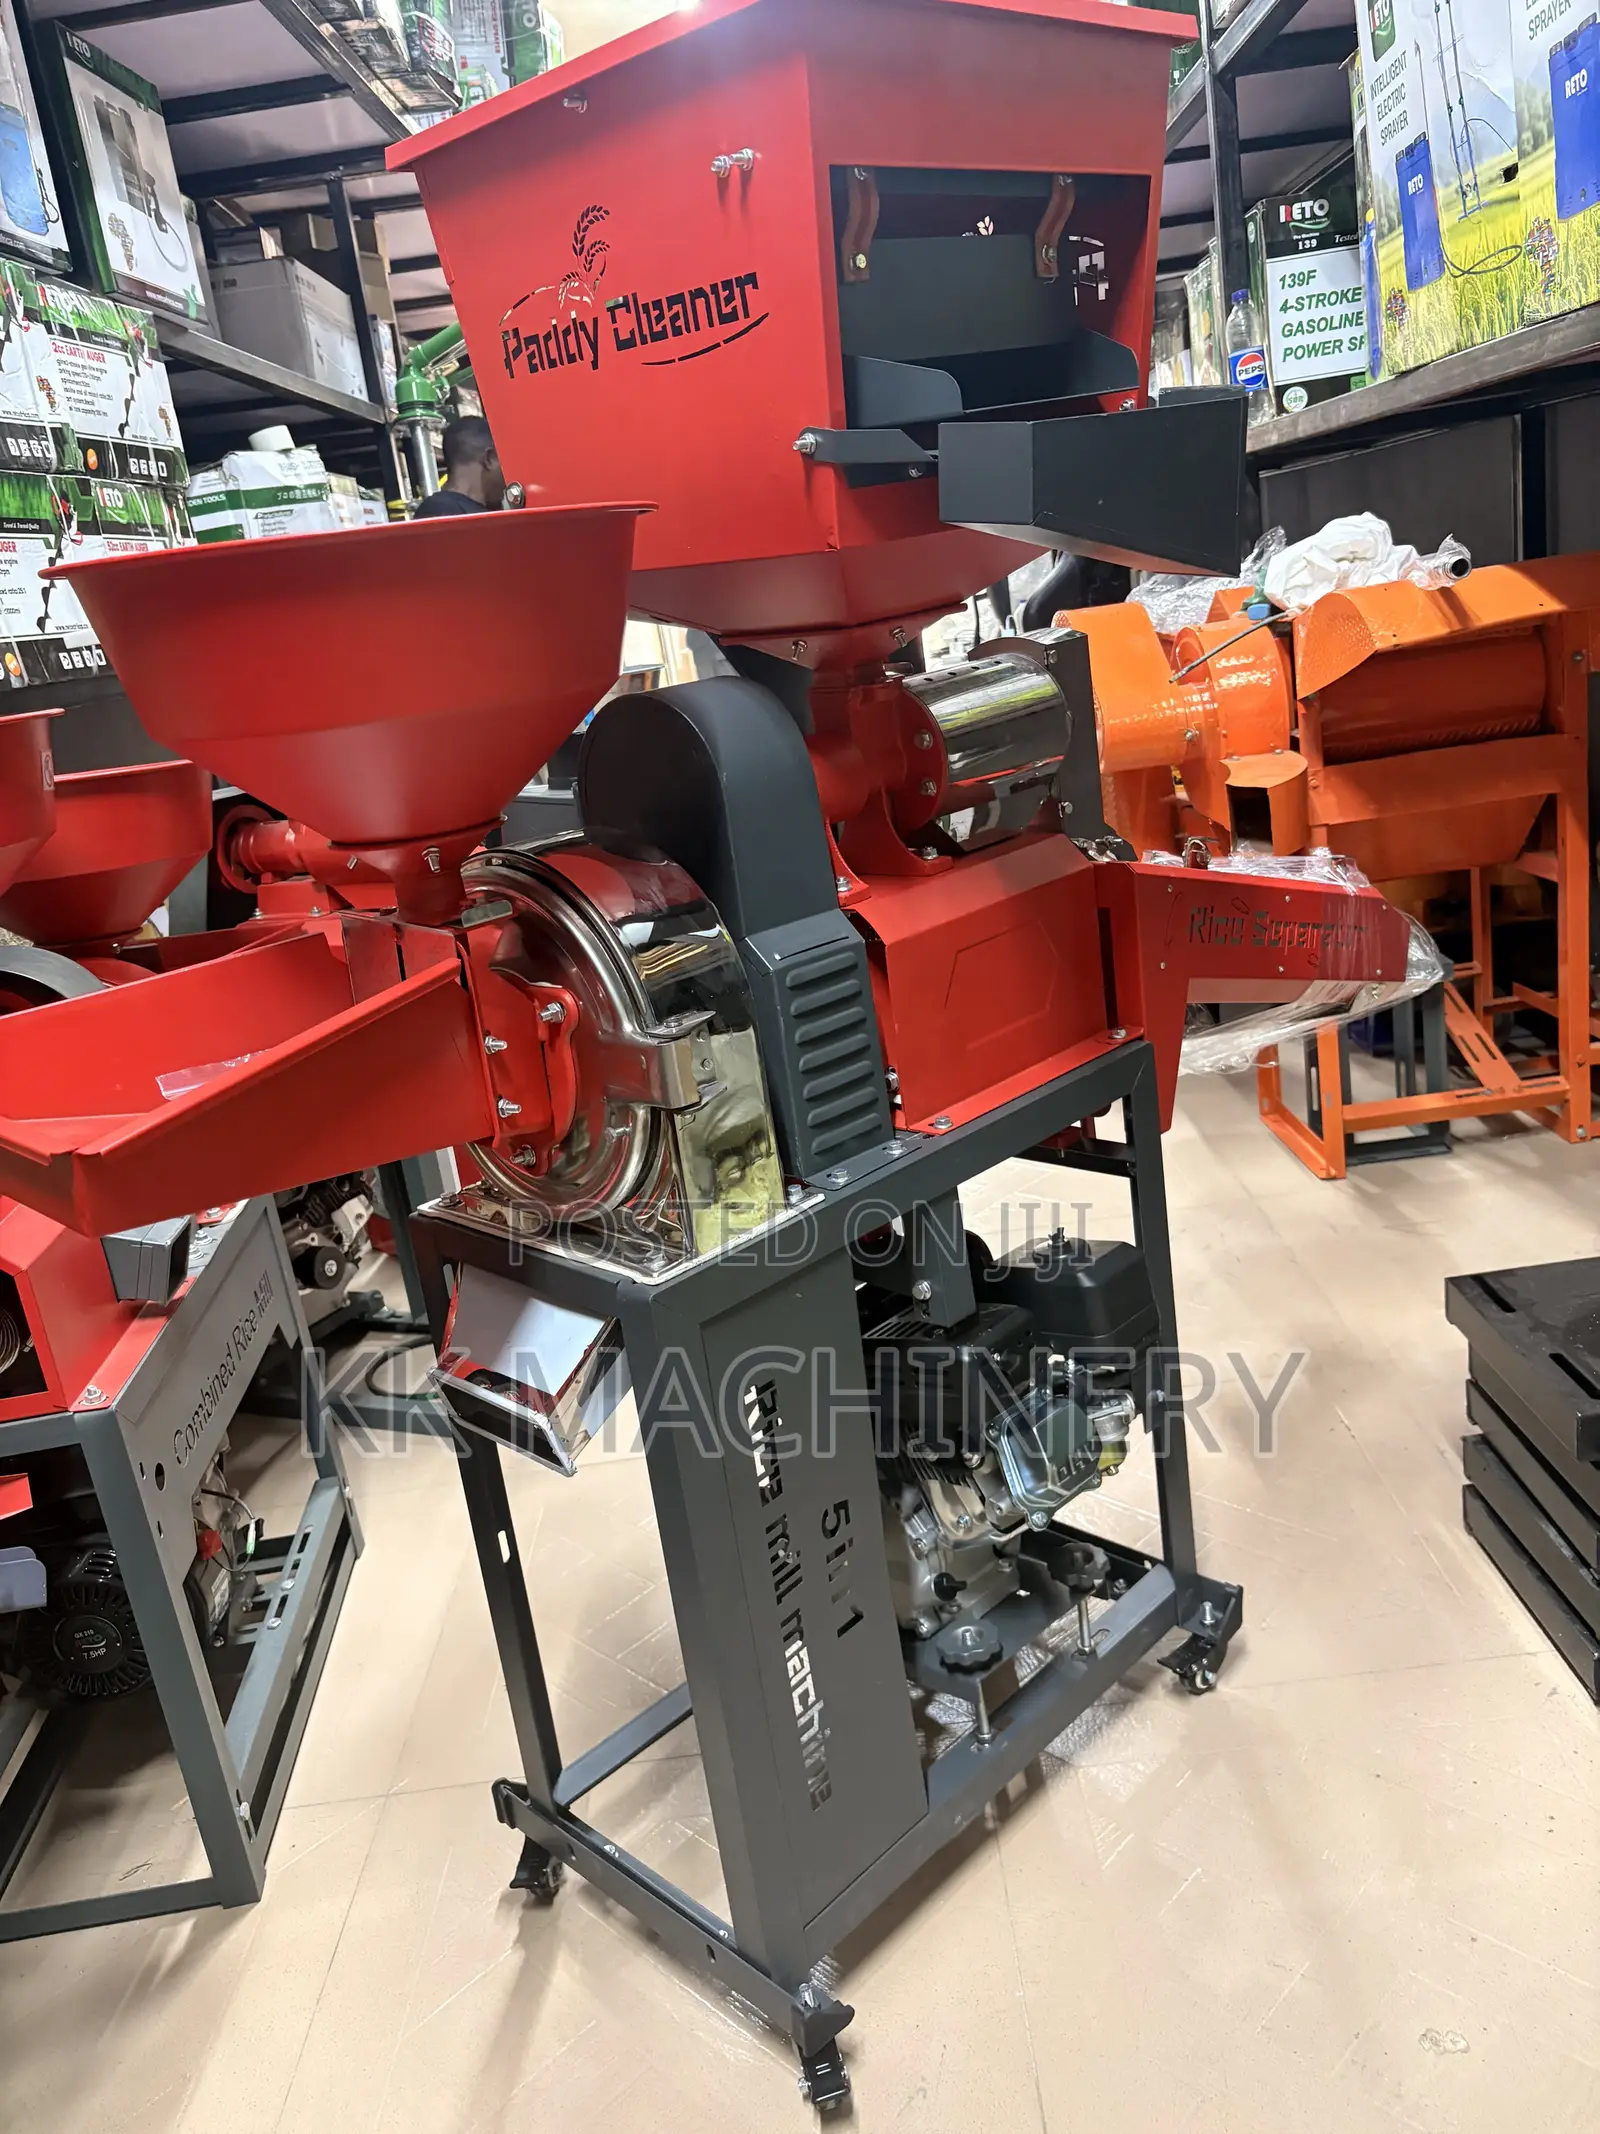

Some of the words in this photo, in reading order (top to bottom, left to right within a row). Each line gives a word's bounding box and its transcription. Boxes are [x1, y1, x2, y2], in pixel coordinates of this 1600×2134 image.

[1370, 50, 1408, 101] INTELLIGENT
[1565, 68, 1588, 99] RETO
[1377, 82, 1407, 122] ELECTRIC
[1380, 109, 1409, 146] SPRAYER
[1408, 173, 1424, 196] RETO
[1280, 198, 1330, 223] RETO
[1298, 239, 1318, 250] 139
[1279, 269, 1317, 290] 139F
[1280, 286, 1363, 314] 4-STROKE
[501, 310, 600, 380] Paddy
[605, 271, 760, 352] Cleaner
[1282, 310, 1364, 338] GASOLINE
[86, 350, 107, 364] AUGER
[1282, 338, 1343, 362] POWER
[204, 493, 227, 504] TOOLS
[173, 1342, 236, 1468] Combined
[231, 1308, 259, 1361] Rice
[254, 1269, 275, 1319] Mill
[765, 1512, 803, 1606] mill
[82, 1647, 107, 1661] 7.5HP
[780, 1606, 834, 1812] machine
